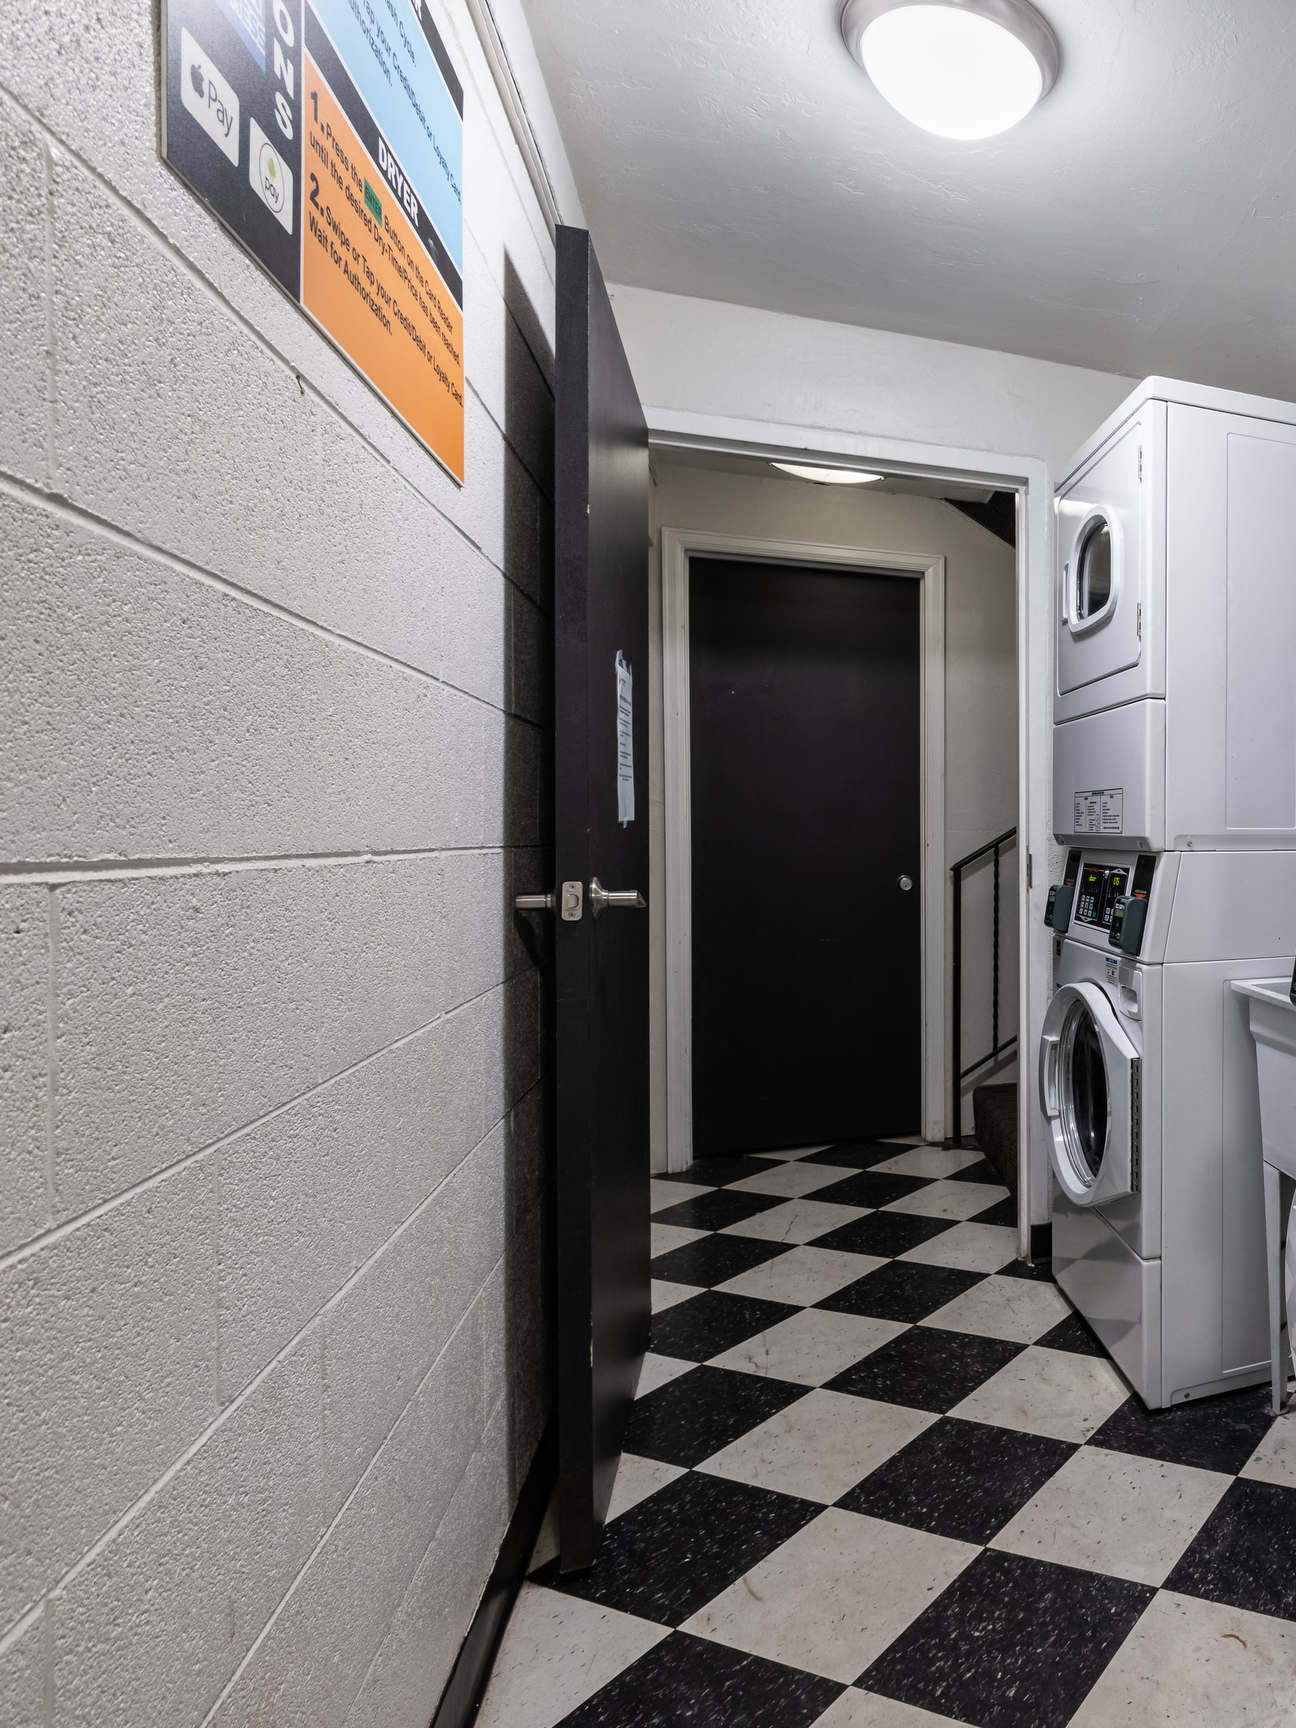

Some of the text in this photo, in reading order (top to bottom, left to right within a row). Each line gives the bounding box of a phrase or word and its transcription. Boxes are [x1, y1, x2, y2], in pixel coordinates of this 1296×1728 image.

[376, 22, 391, 57] your
[208, 79, 233, 137] Pay
[309, 130, 329, 169] until
[330, 159, 343, 191] the
[344, 183, 373, 234] desired
[418, 290, 429, 318] has
[429, 308, 441, 337] been
[326, 121, 349, 171] Press
[350, 162, 363, 193] the
[384, 215, 406, 260] Button
[406, 253, 415, 272] on
[415, 262, 424, 287] the
[425, 279, 437, 308] Card
[378, 135, 420, 227] DRYER
[309, 210, 393, 337] Wait for Authorization.
[325, 206, 350, 252] Swipe
[351, 246, 361, 265] or
[362, 255, 375, 287] Tap
[376, 279, 392, 309] your
[433, 355, 450, 393] Loyalty
